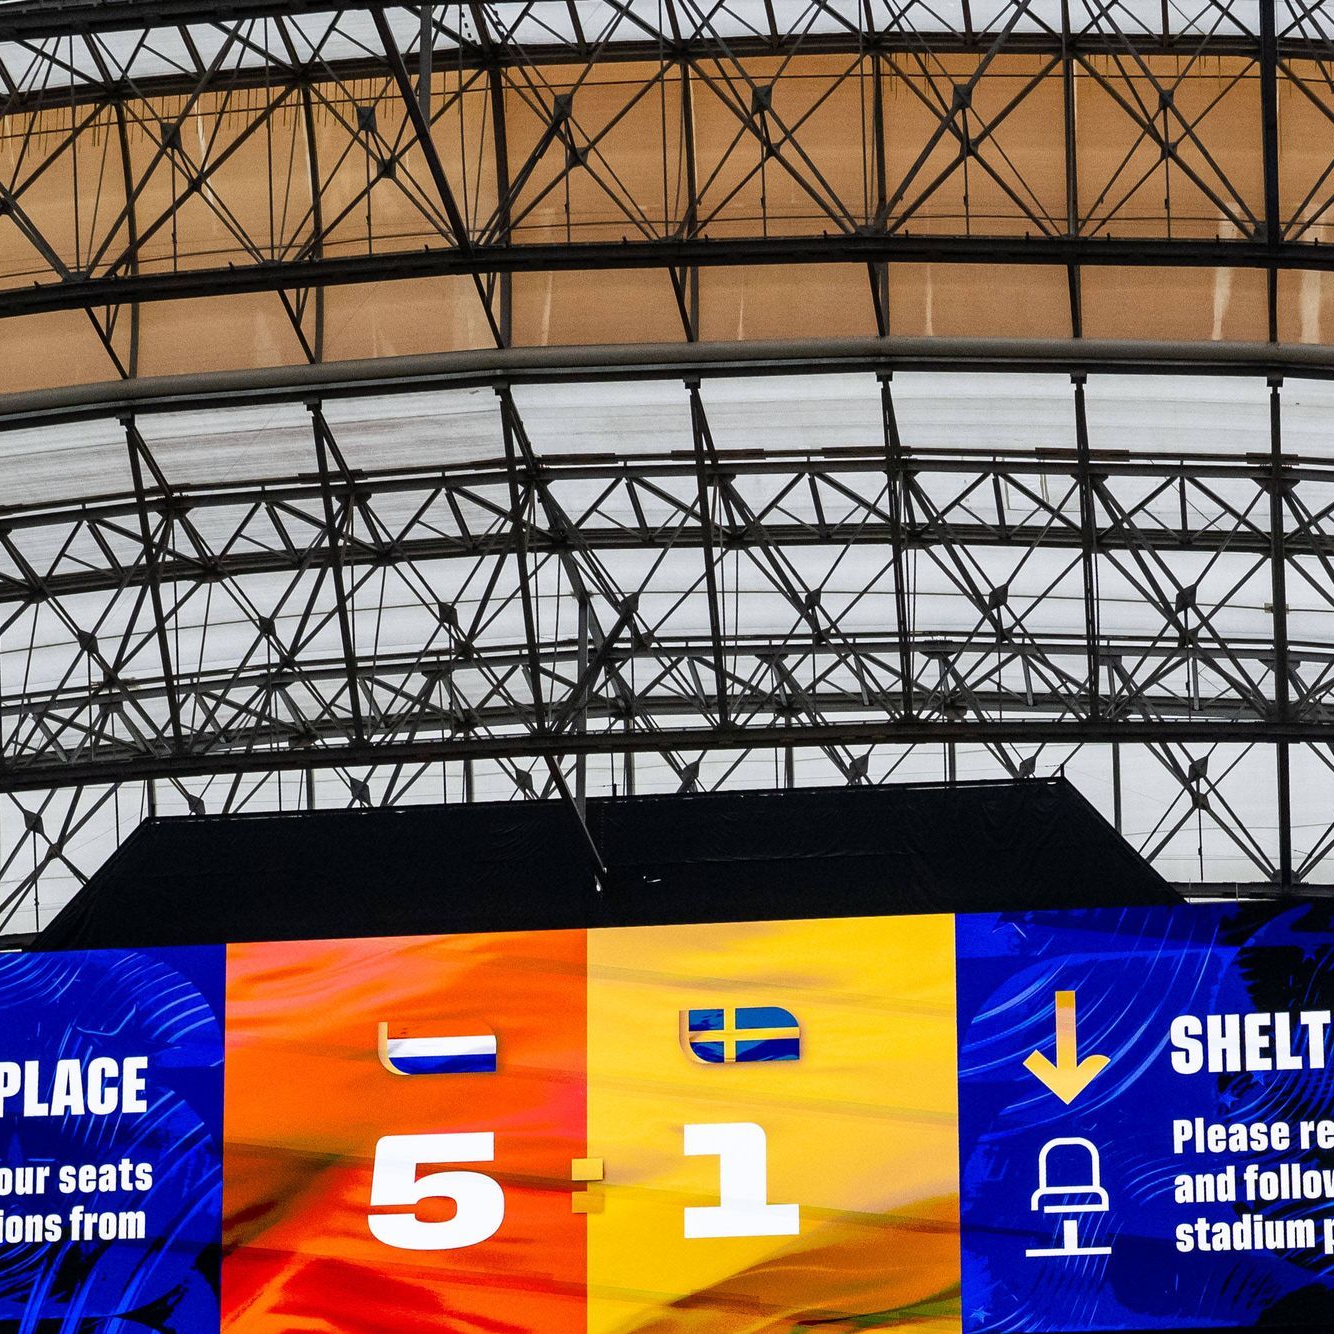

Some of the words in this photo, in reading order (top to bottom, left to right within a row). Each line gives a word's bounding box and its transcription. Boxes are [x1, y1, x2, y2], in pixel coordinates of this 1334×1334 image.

[1174, 1118, 1289, 1153] Please
[59, 1159, 152, 1193] seats
[369, 1133, 504, 1249] 5
[685, 1123, 799, 1238] 1
[1175, 1166, 1235, 1203] and
[70, 1206, 145, 1240] from
[1176, 1214, 1315, 1252] stadium
